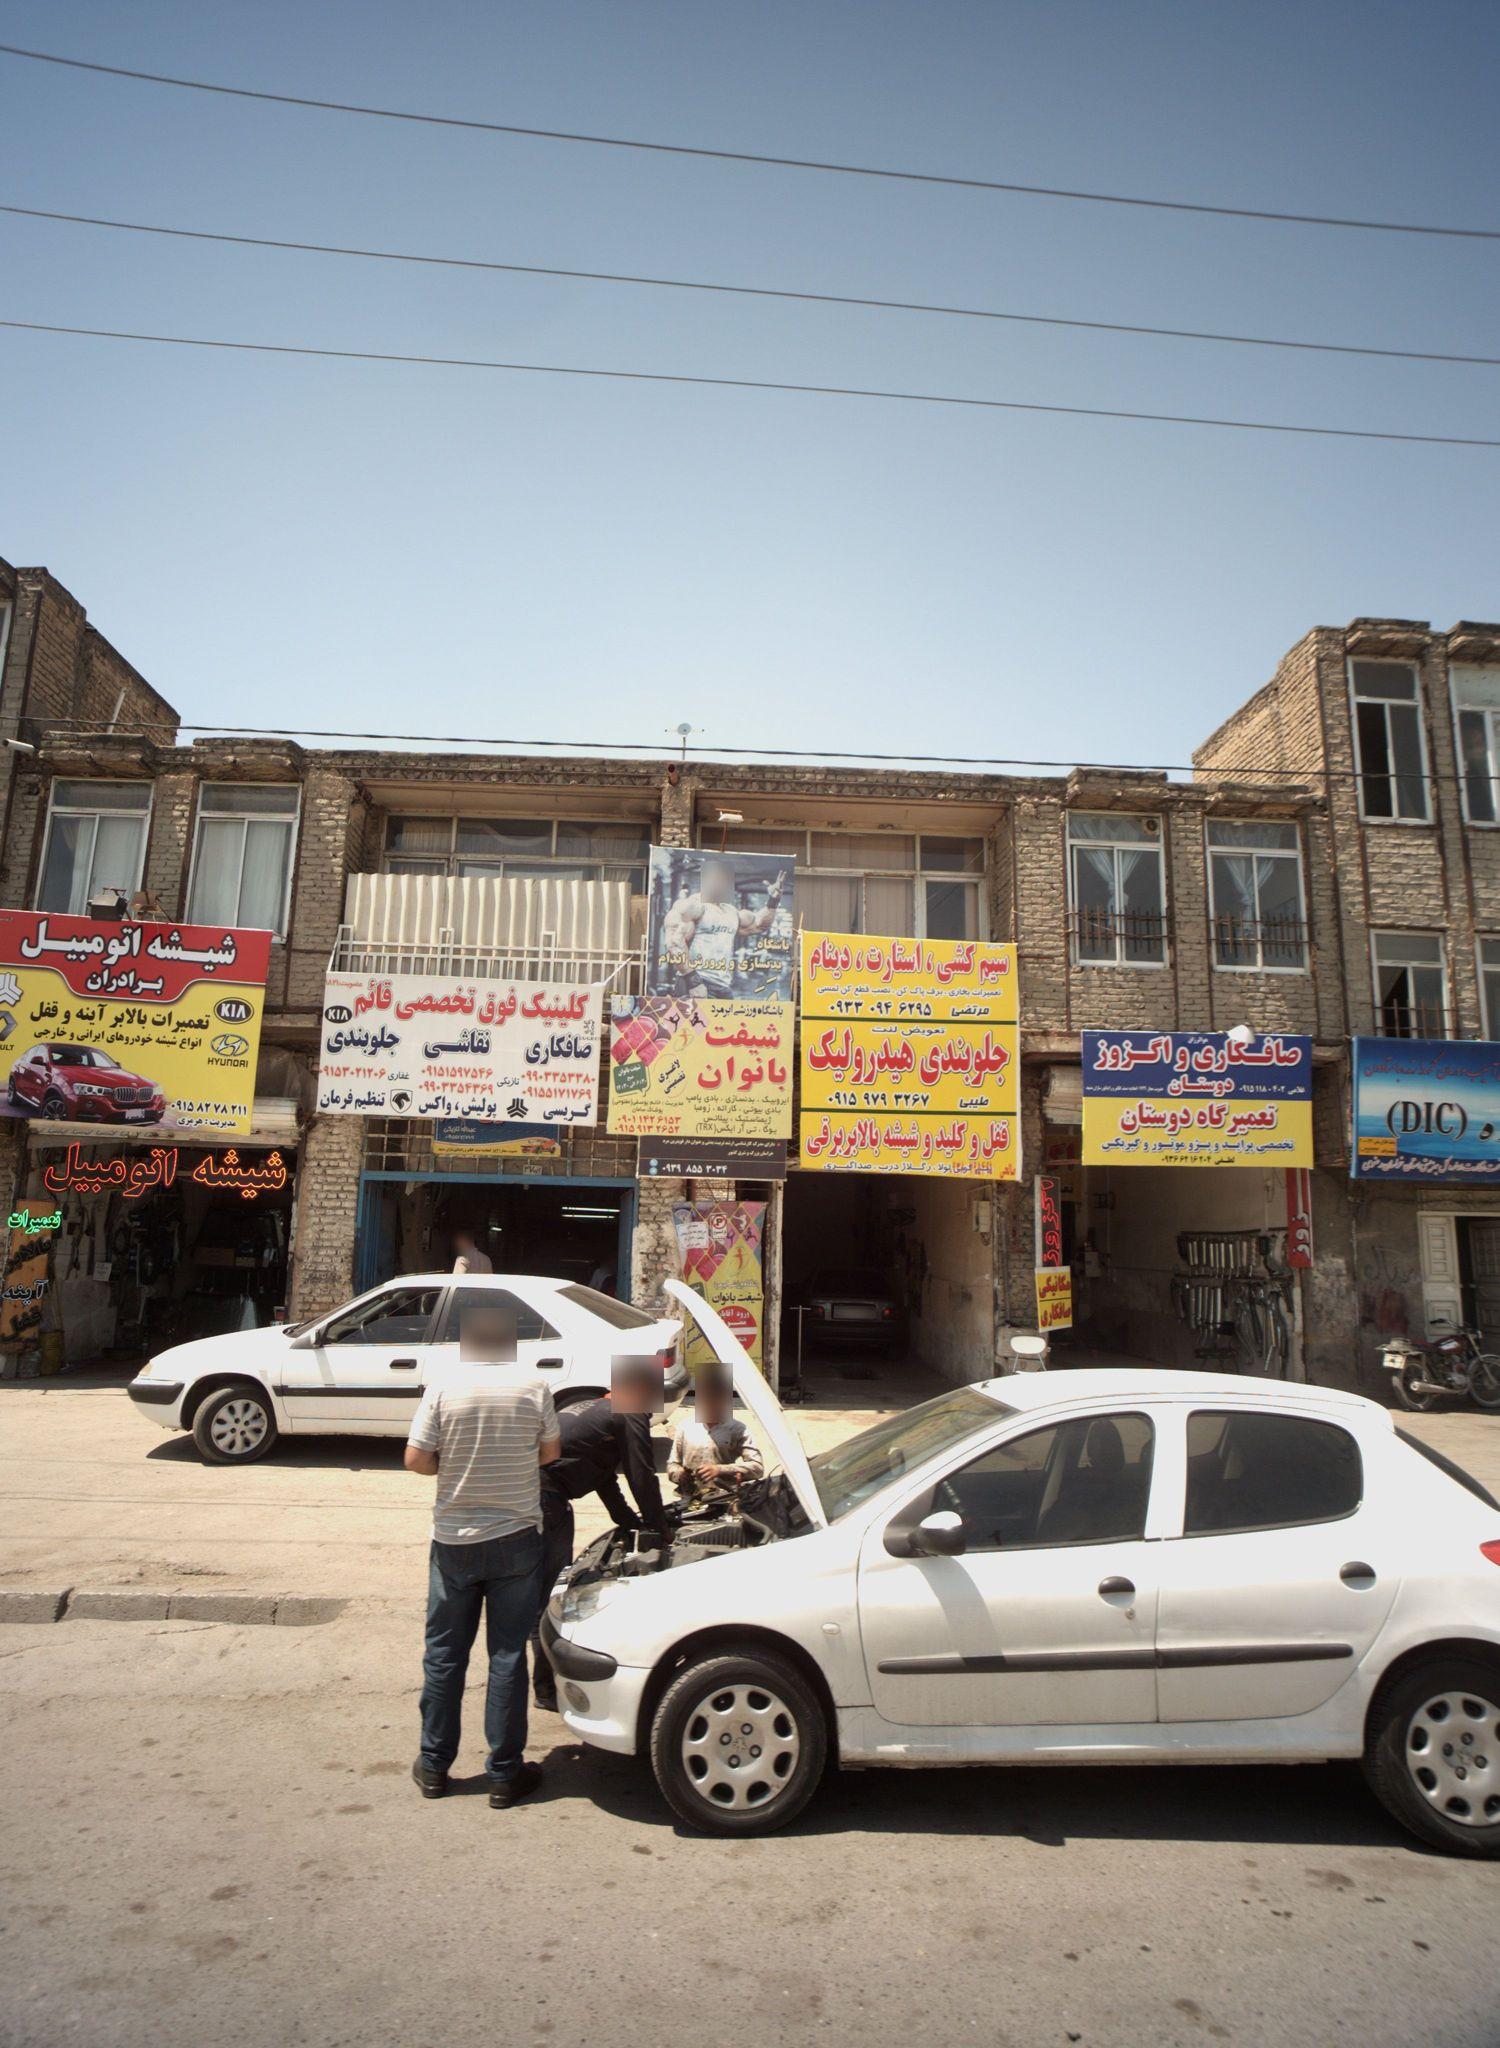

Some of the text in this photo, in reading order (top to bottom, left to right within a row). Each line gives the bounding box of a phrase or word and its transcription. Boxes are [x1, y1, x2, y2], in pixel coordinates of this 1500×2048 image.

[21, 920, 236, 971] شیشه اتومبیل
[809, 939, 851, 981] دینام
[866, 939, 923, 983] استارت
[936, 942, 977, 984] کشی
[979, 959, 1009, 984] سیم
[86, 969, 163, 994] برادران
[870, 986, 890, 995] نصب
[927, 987, 943, 996] برف
[949, 987, 970, 997] بخاری
[972, 987, 1001, 997] تعمیرات
[220, 1003, 247, 1019] KIA
[328, 1008, 349, 1020] KIA
[354, 978, 590, 1026] کلینیک فوق تخصصی قائم
[758, 1005, 783, 1016] باشگاه
[951, 1004, 990, 1017] مرتضی
[30, 1001, 210, 1030] تعمیرات بالابر آینه و قفل
[34, 1027, 202, 1049] انواع شیشه خودروهای ایرانی و خارجی
[705, 1022, 780, 1054] شیفت
[871, 1025, 946, 1036] تعویض لنت
[327, 1024, 592, 1064] جلوبندی نقاشی صافکاری
[1094, 1035, 1302, 1072] صافکاری و اگزوز
[207, 1057, 248, 1067] HYUNDAI
[807, 1027, 1010, 1086] جلوبندی هیدرولیک
[697, 1056, 787, 1091] بانوان
[1168, 1075, 1235, 1099] دوستان
[320, 1089, 386, 1110] تنظیم فرمان
[418, 1095, 497, 1118] پولیش واکس
[827, 1091, 857, 1106] ۰۹۱۵
[864, 1093, 887, 1106] ۹۷۹
[959, 1097, 989, 1108] طیبی
[1120, 1101, 1194, 1133] دوستان
[883, 1120, 919, 1157] شیشه
[922, 1137, 931, 1158] و
[935, 1121, 967, 1156] کلید
[969, 1137, 979, 1158] و
[982, 1120, 1009, 1157] قفل
[1143, 1141, 1149, 1150] و
[1151, 1136, 1186, 1150] موتور
[1214, 1141, 1220, 1150] و
[1256, 1138, 1294, 1150] تخصصی
[44, 1141, 287, 1199] شیشه اتومبیل
[7, 1209, 62, 1235] تعمیرات
[2, 1279, 49, 1308] آینه
